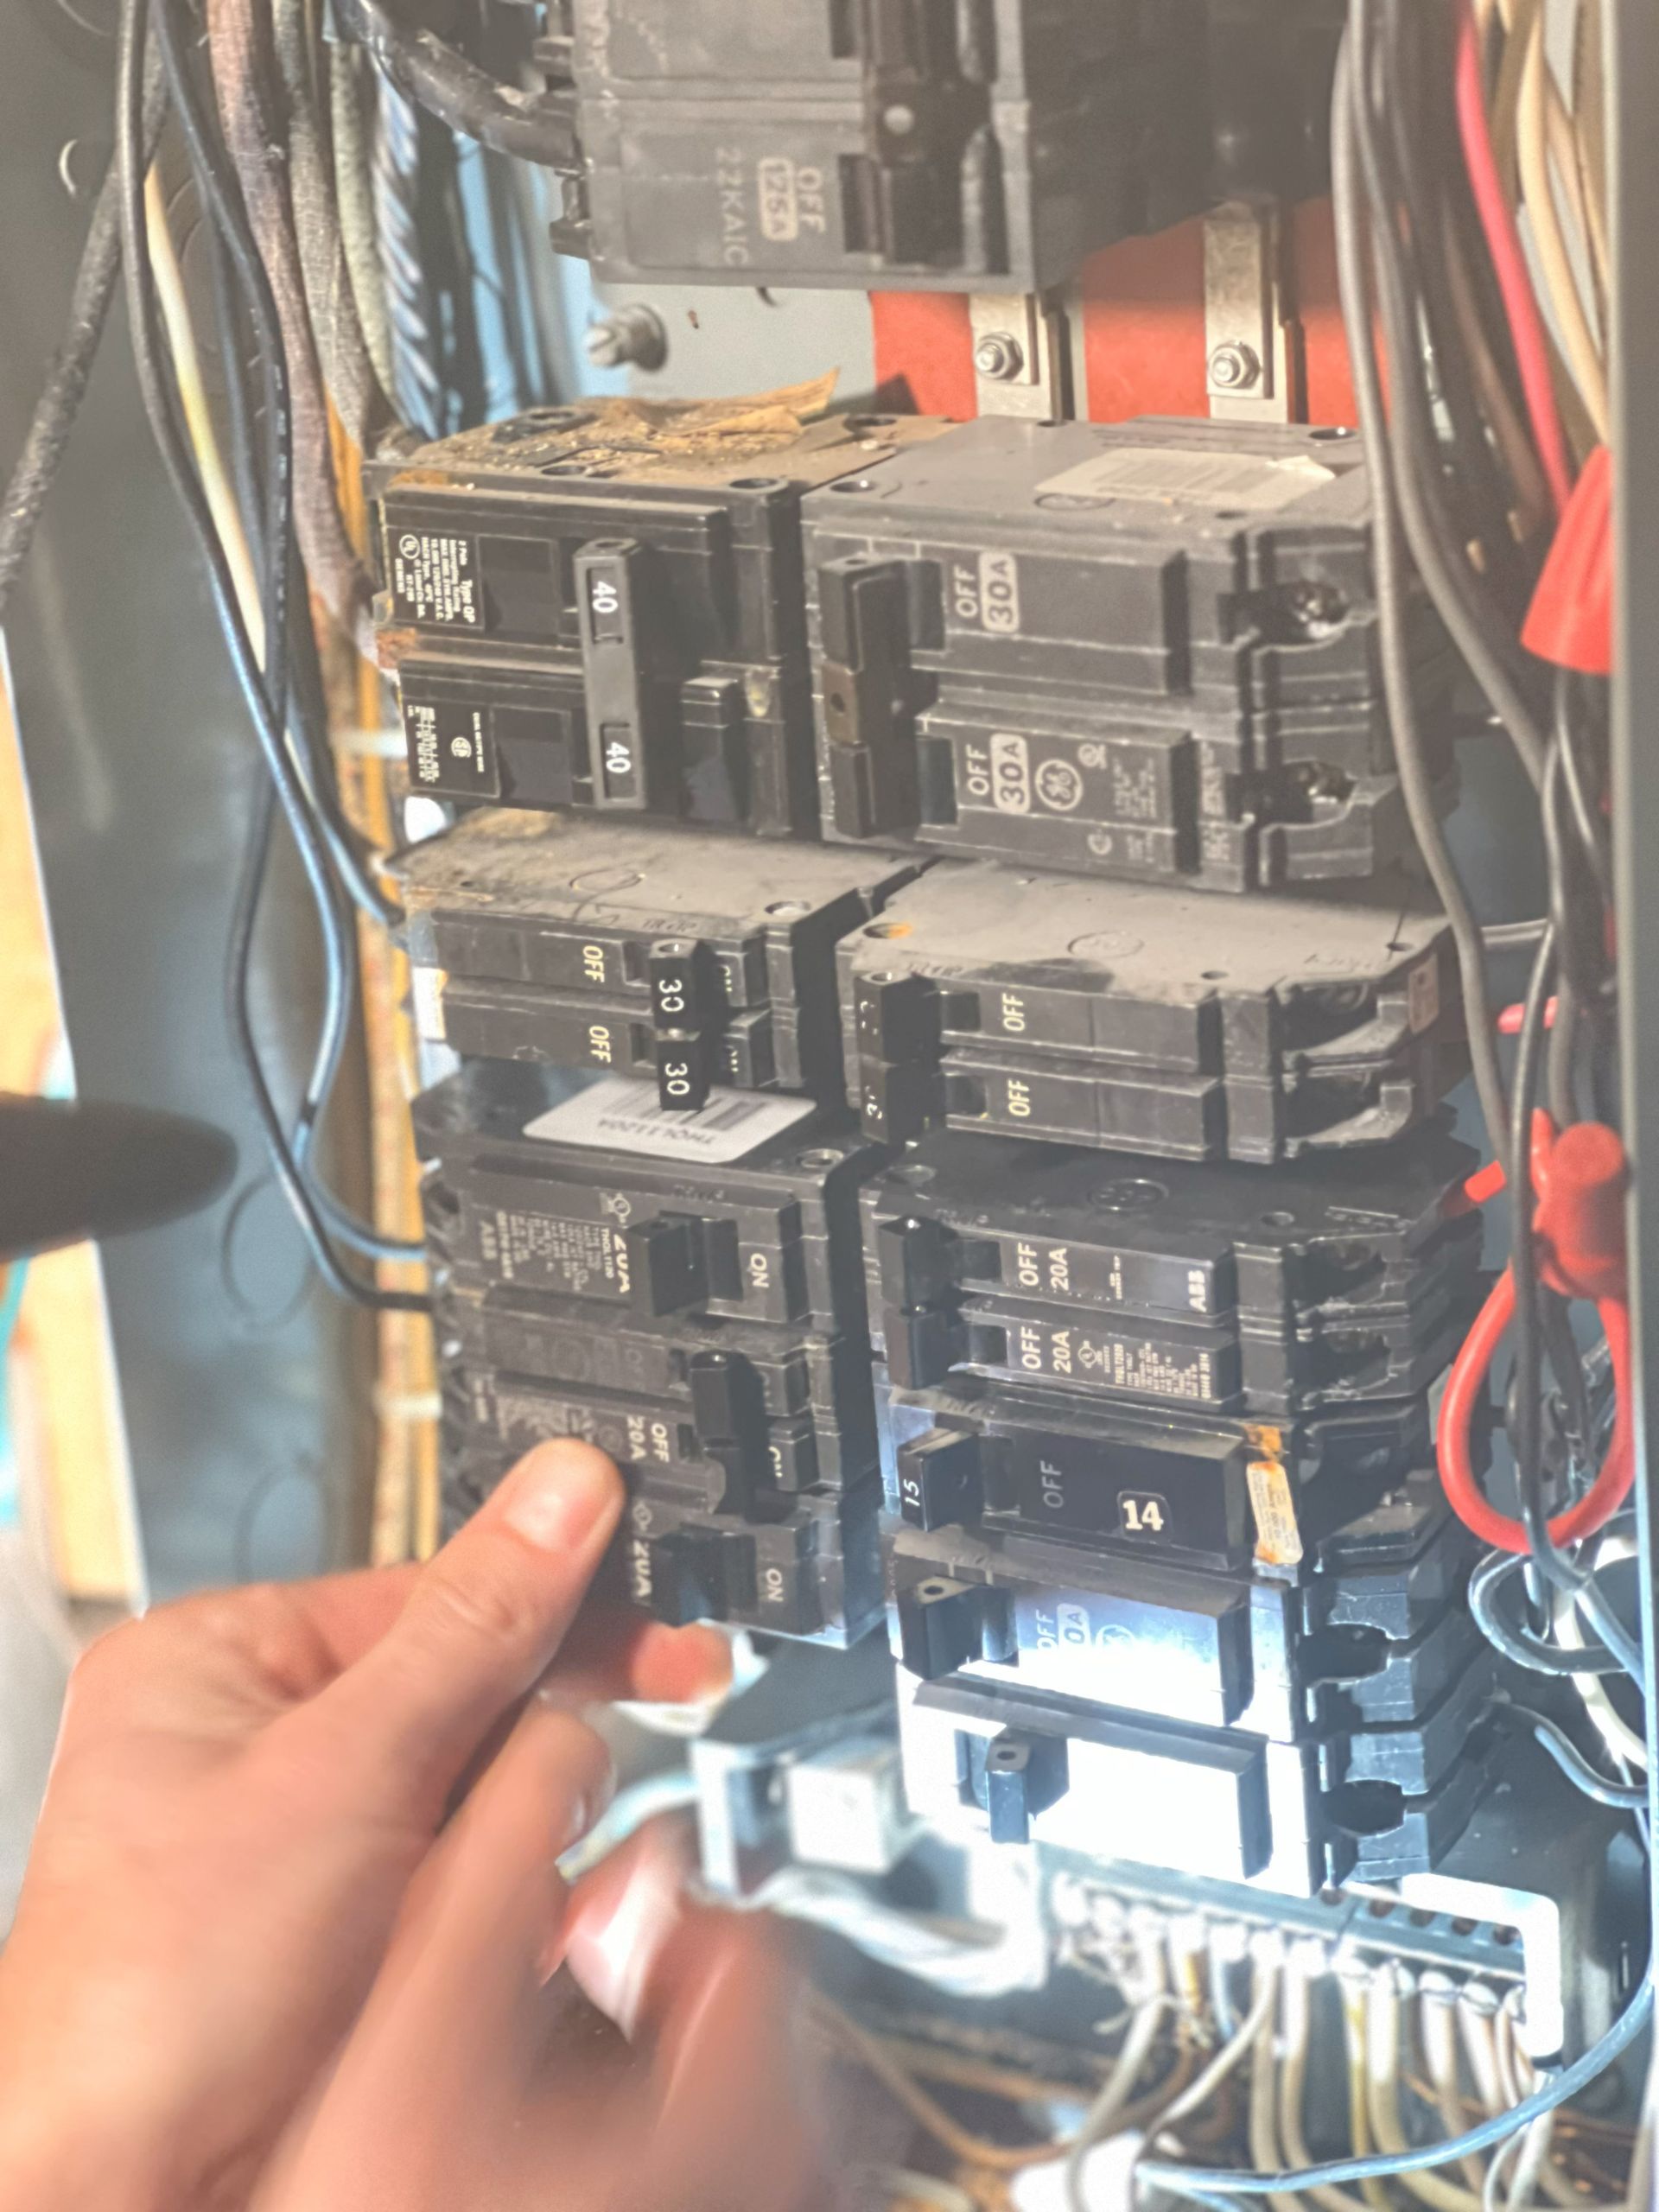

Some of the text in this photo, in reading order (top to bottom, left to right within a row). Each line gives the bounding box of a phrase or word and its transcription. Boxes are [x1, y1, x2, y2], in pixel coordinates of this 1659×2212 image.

[716, 147, 748, 265] 22KAIC
[764, 164, 789, 233] 125A
[798, 167, 825, 232] OFF
[592, 581, 618, 613] 40
[954, 564, 976, 618] OFF
[988, 560, 1014, 626] 30A
[606, 741, 632, 774] 40
[966, 744, 989, 796] OFF
[1000, 742, 1024, 804] 30A
[582, 946, 605, 983] OFF
[658, 979, 684, 1012] 30
[1002, 992, 1026, 1032] OFF
[588, 1026, 613, 1063] OFF
[664, 1063, 690, 1095] 30
[1007, 1079, 1032, 1118] OFF
[751, 1253, 770, 1288] ON
[1018, 1243, 1039, 1286] OFF
[1049, 1248, 1069, 1290] 20A
[1187, 1270, 1206, 1313] ABB
[1021, 1326, 1041, 1370] OFF
[1052, 1331, 1071, 1373] 20A
[627, 1414, 645, 1459] 20A
[652, 1422, 669, 1463] OFF
[903, 1479, 920, 1507] 15
[1039, 1460, 1064, 1509] OFF
[1122, 1499, 1164, 1531] 14
[766, 1568, 784, 1602] ON
[1036, 1609, 1058, 1650] OFF
